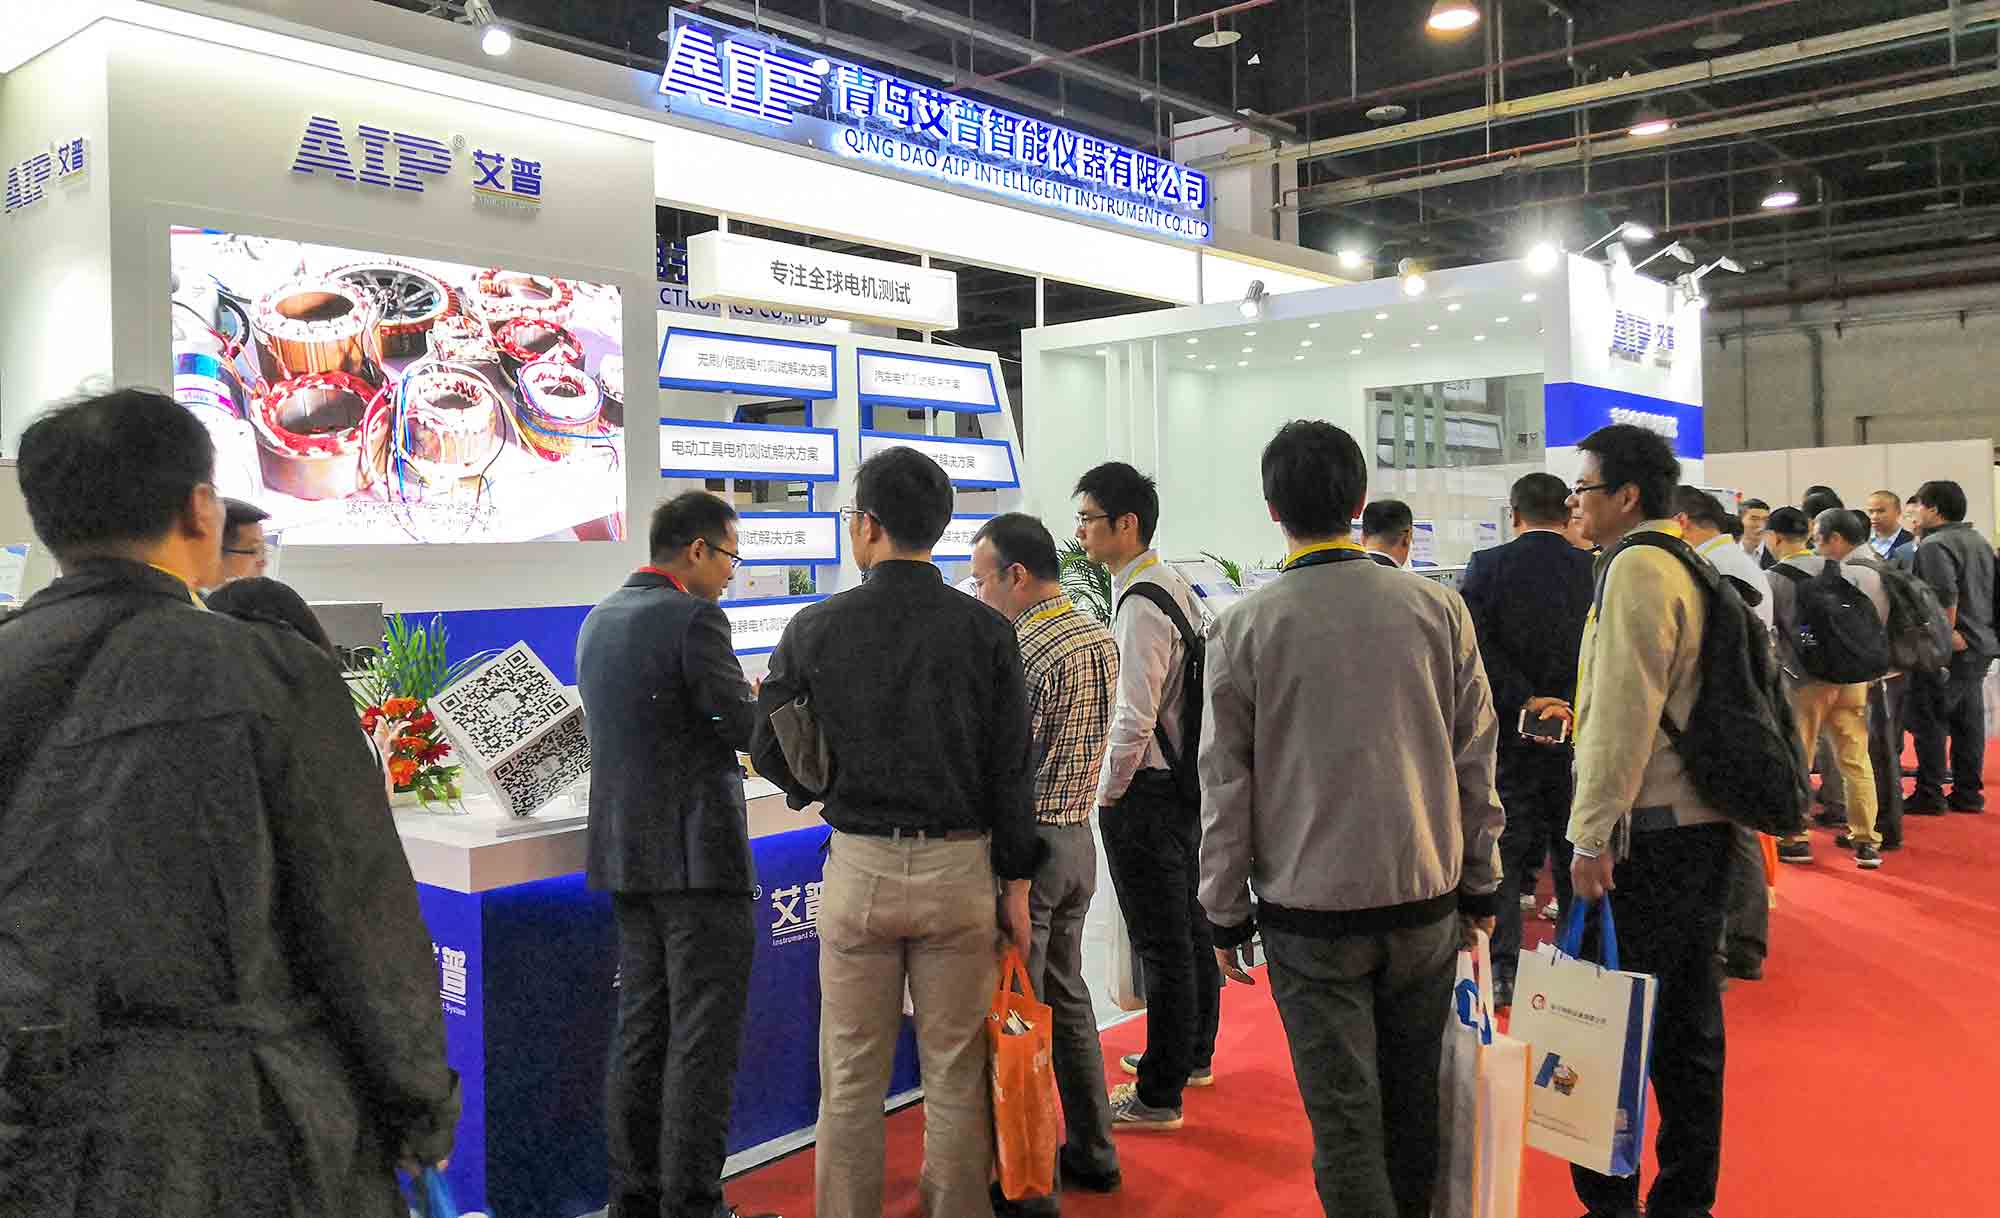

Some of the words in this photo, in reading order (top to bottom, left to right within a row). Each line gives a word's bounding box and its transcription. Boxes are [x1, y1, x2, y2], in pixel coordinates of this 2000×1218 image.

[660, 25, 822, 128] AIP
[58, 136, 84, 176] 艾普
[291, 114, 452, 193] AIP
[837, 66, 1207, 210] 青岛艾普智能仪器有限公司
[5, 152, 52, 214] AIP
[472, 148, 543, 197] 艾普
[845, 128, 895, 159] QING
[900, 143, 938, 168] DAO
[941, 155, 971, 177] AIP
[974, 161, 1072, 201] INTELLIGENT
[1074, 187, 1162, 227] INSTRUMENT
[769, 259, 912, 305] 专注全球电机测试
[671, 439, 820, 462] 电动工具电机测试解决方案
